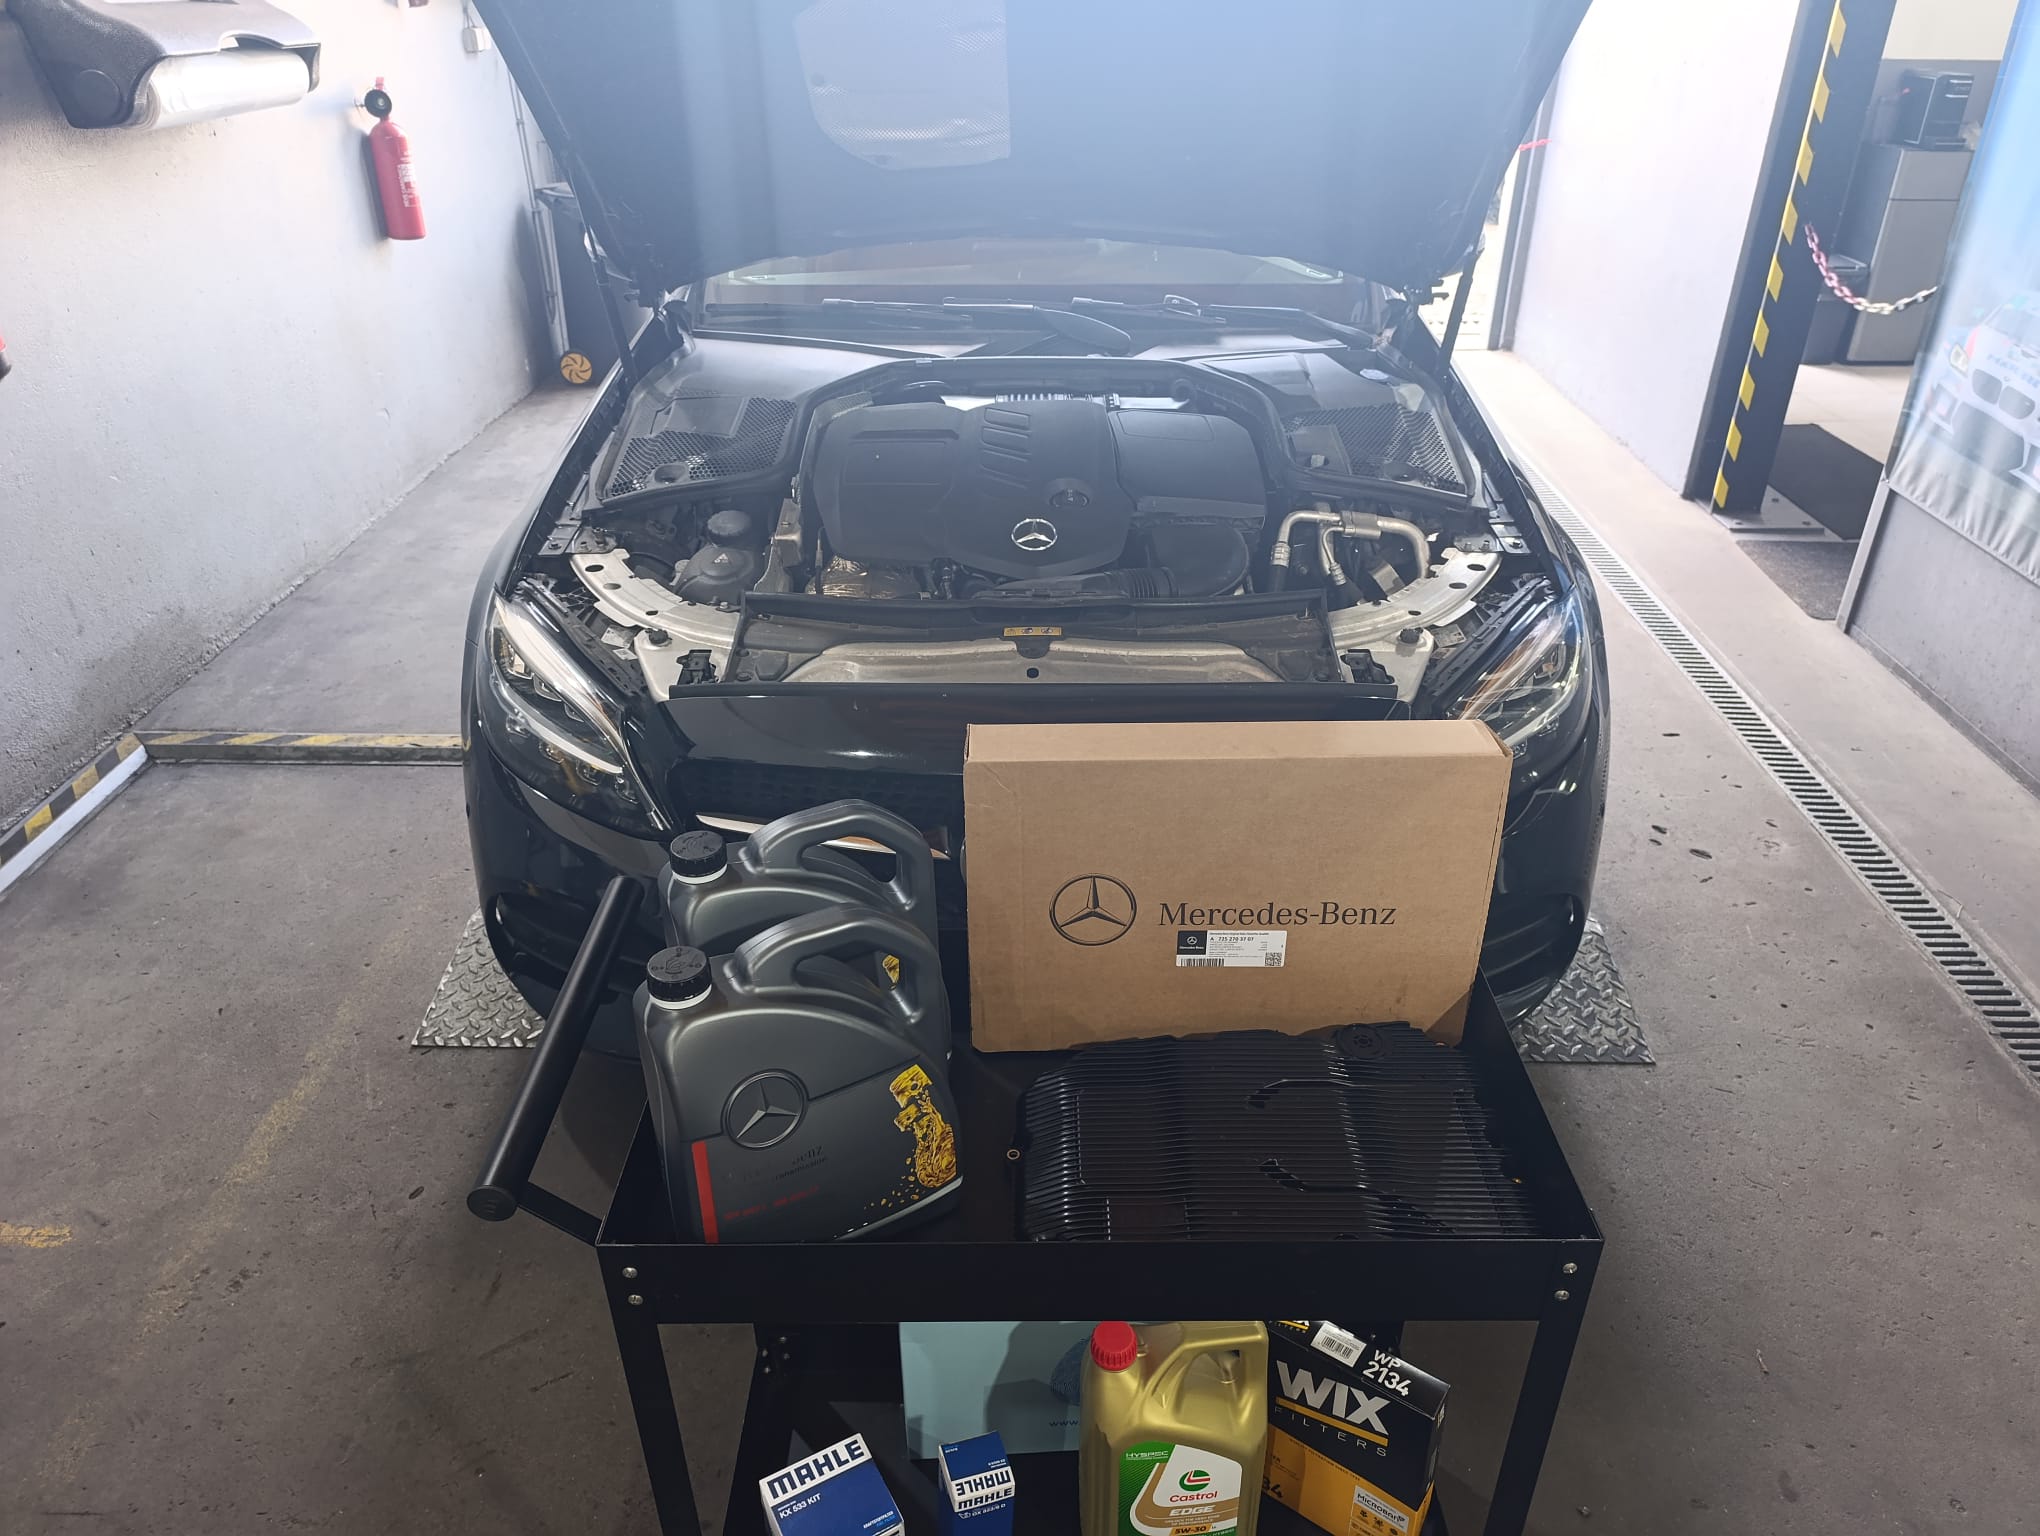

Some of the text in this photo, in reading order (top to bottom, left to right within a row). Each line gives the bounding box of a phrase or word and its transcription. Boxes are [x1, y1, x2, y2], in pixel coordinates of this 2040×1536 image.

[1159, 901, 1397, 926] Mercedes-Benz
[1374, 1349, 1401, 1368] WP
[1362, 1361, 1412, 1397] 2134
[1276, 1360, 1391, 1436] WIX
[1274, 1407, 1387, 1457] FILTERS
[1125, 1450, 1169, 1458] HYSPEC
[766, 1439, 865, 1499] MAHLE
[955, 1470, 1011, 1497] MAHLE
[779, 1508, 793, 1519] KX
[793, 1501, 808, 1513] 533
[807, 1493, 822, 1505] KIT
[958, 1487, 1013, 1510] MAHLE
[1169, 1491, 1218, 1503] Castrol
[1168, 1504, 1217, 1517] EDGE
[1174, 1525, 1208, 1535] 5W-30
